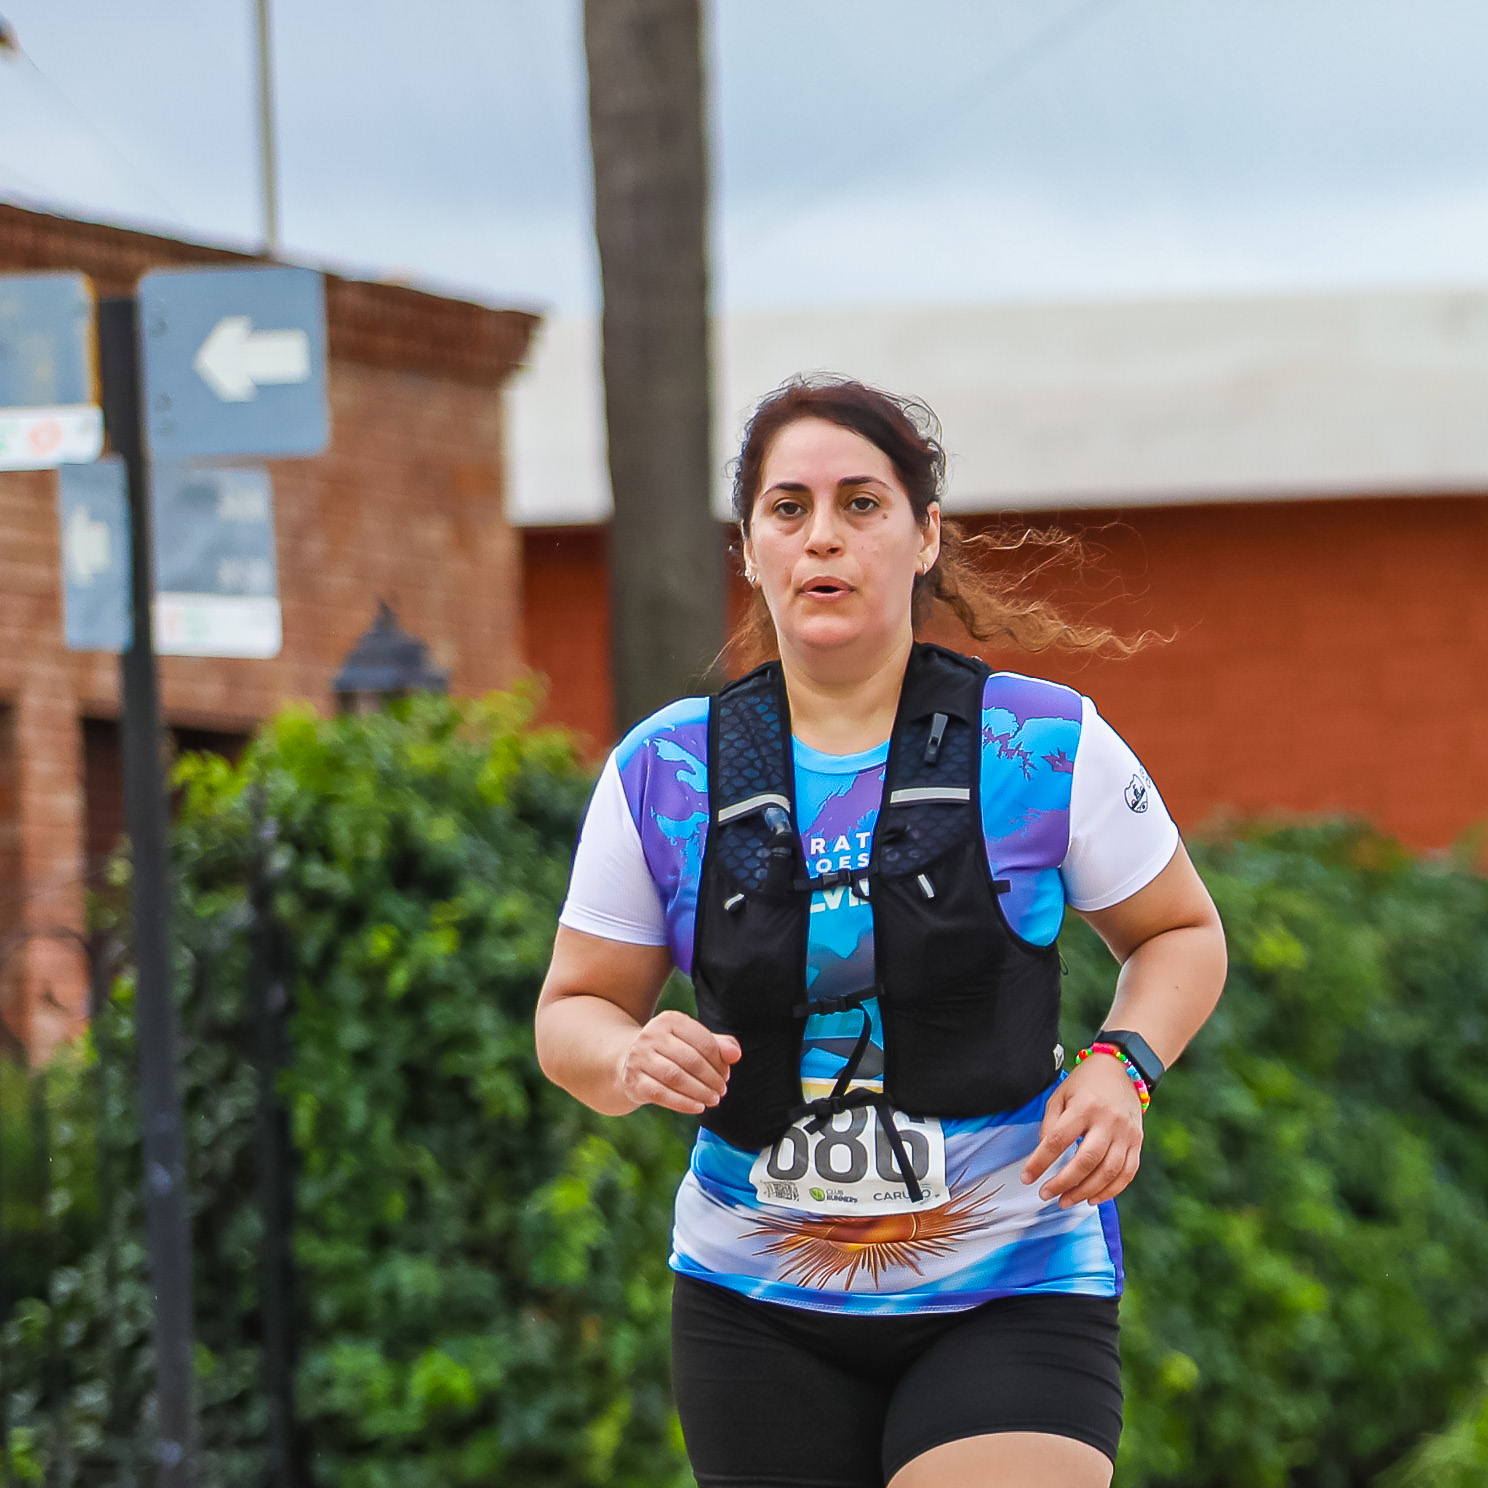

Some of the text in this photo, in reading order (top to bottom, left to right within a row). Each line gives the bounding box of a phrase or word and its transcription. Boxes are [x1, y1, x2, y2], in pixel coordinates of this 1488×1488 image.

[805, 852, 870, 873] OES
[767, 1106, 929, 1183] 686
[873, 1188, 931, 1201] CARUO
